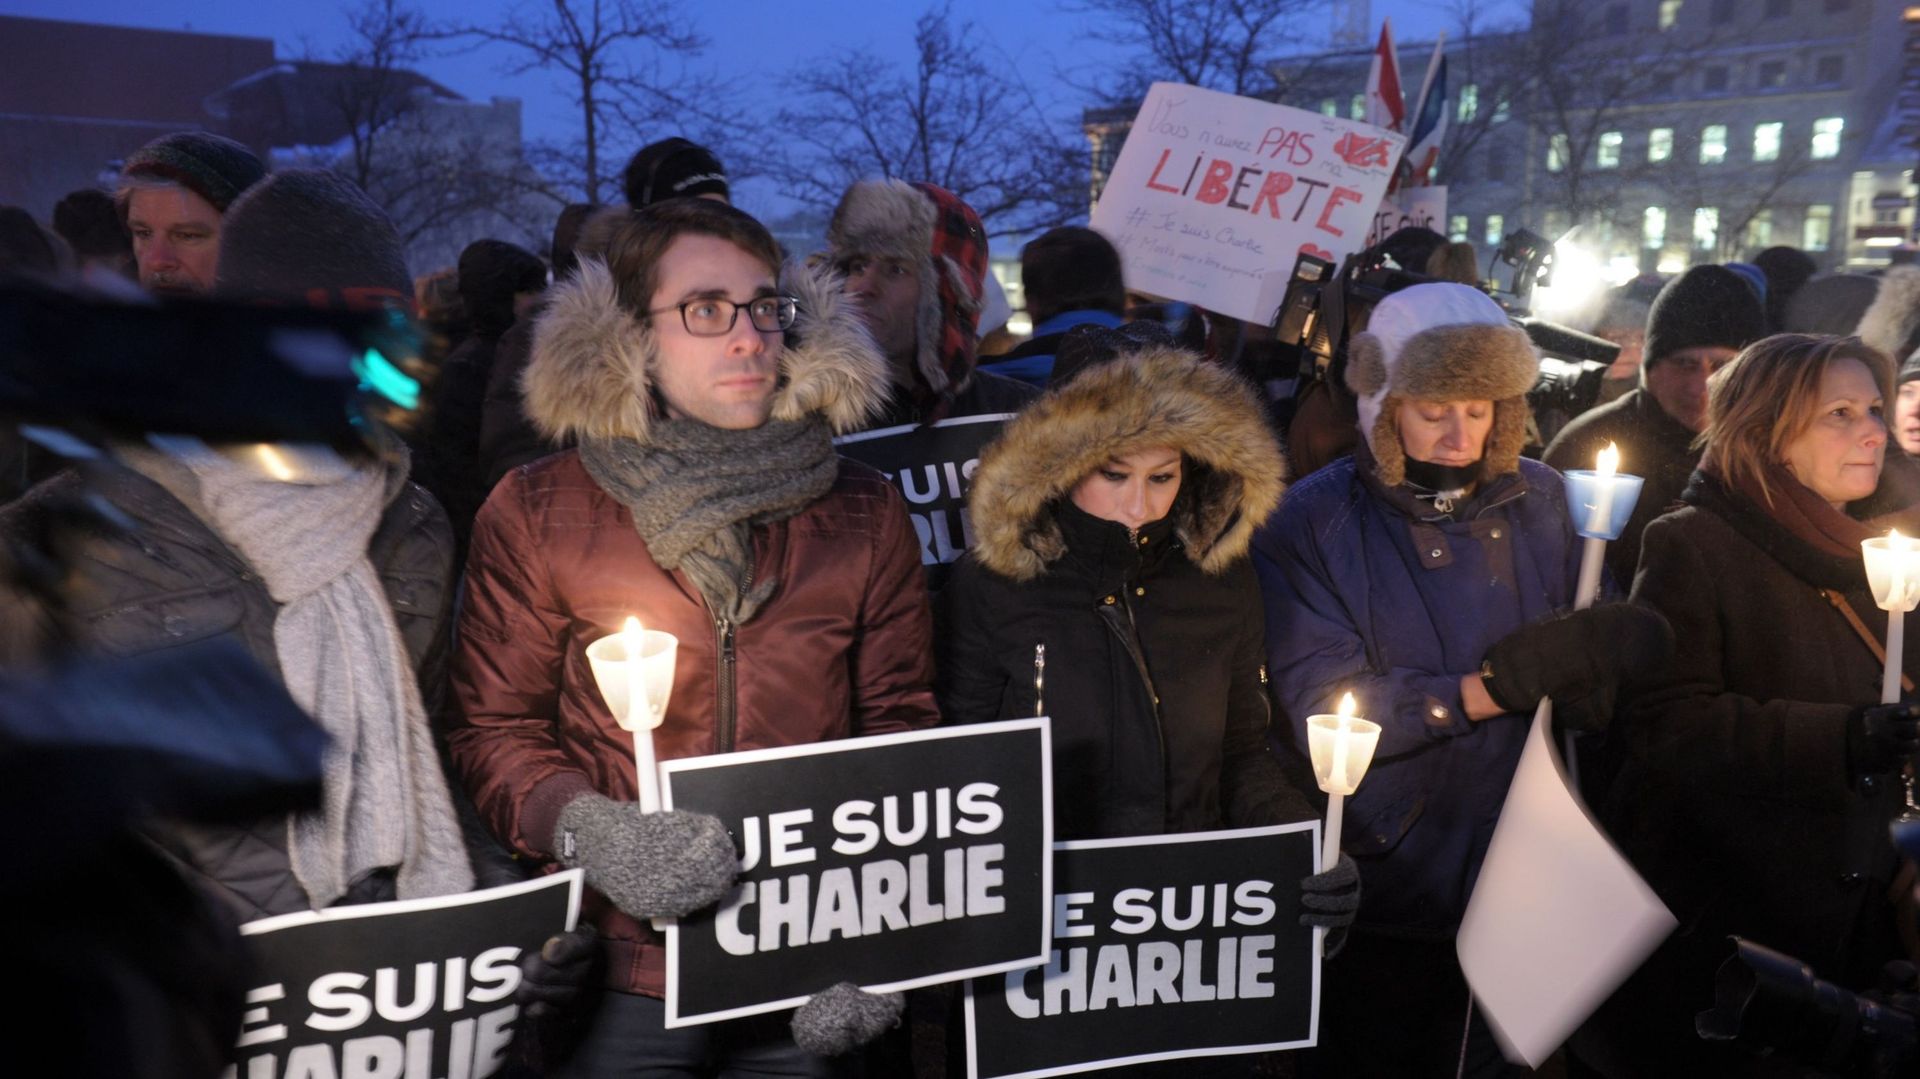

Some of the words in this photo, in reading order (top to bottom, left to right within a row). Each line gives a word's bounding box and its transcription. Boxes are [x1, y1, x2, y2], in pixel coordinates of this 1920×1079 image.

[1148, 96, 1189, 138] Vous
[1257, 126, 1315, 166] PAS
[738, 808, 817, 872] JE
[831, 782, 1004, 855] SUIS
[714, 843, 1006, 956] CHARLIE
[1053, 892, 1095, 938] E
[1110, 879, 1277, 935] SUIS
[236, 982, 288, 1047] E
[304, 945, 524, 1032] SUIS
[1005, 934, 1276, 1019] CHARLIE
